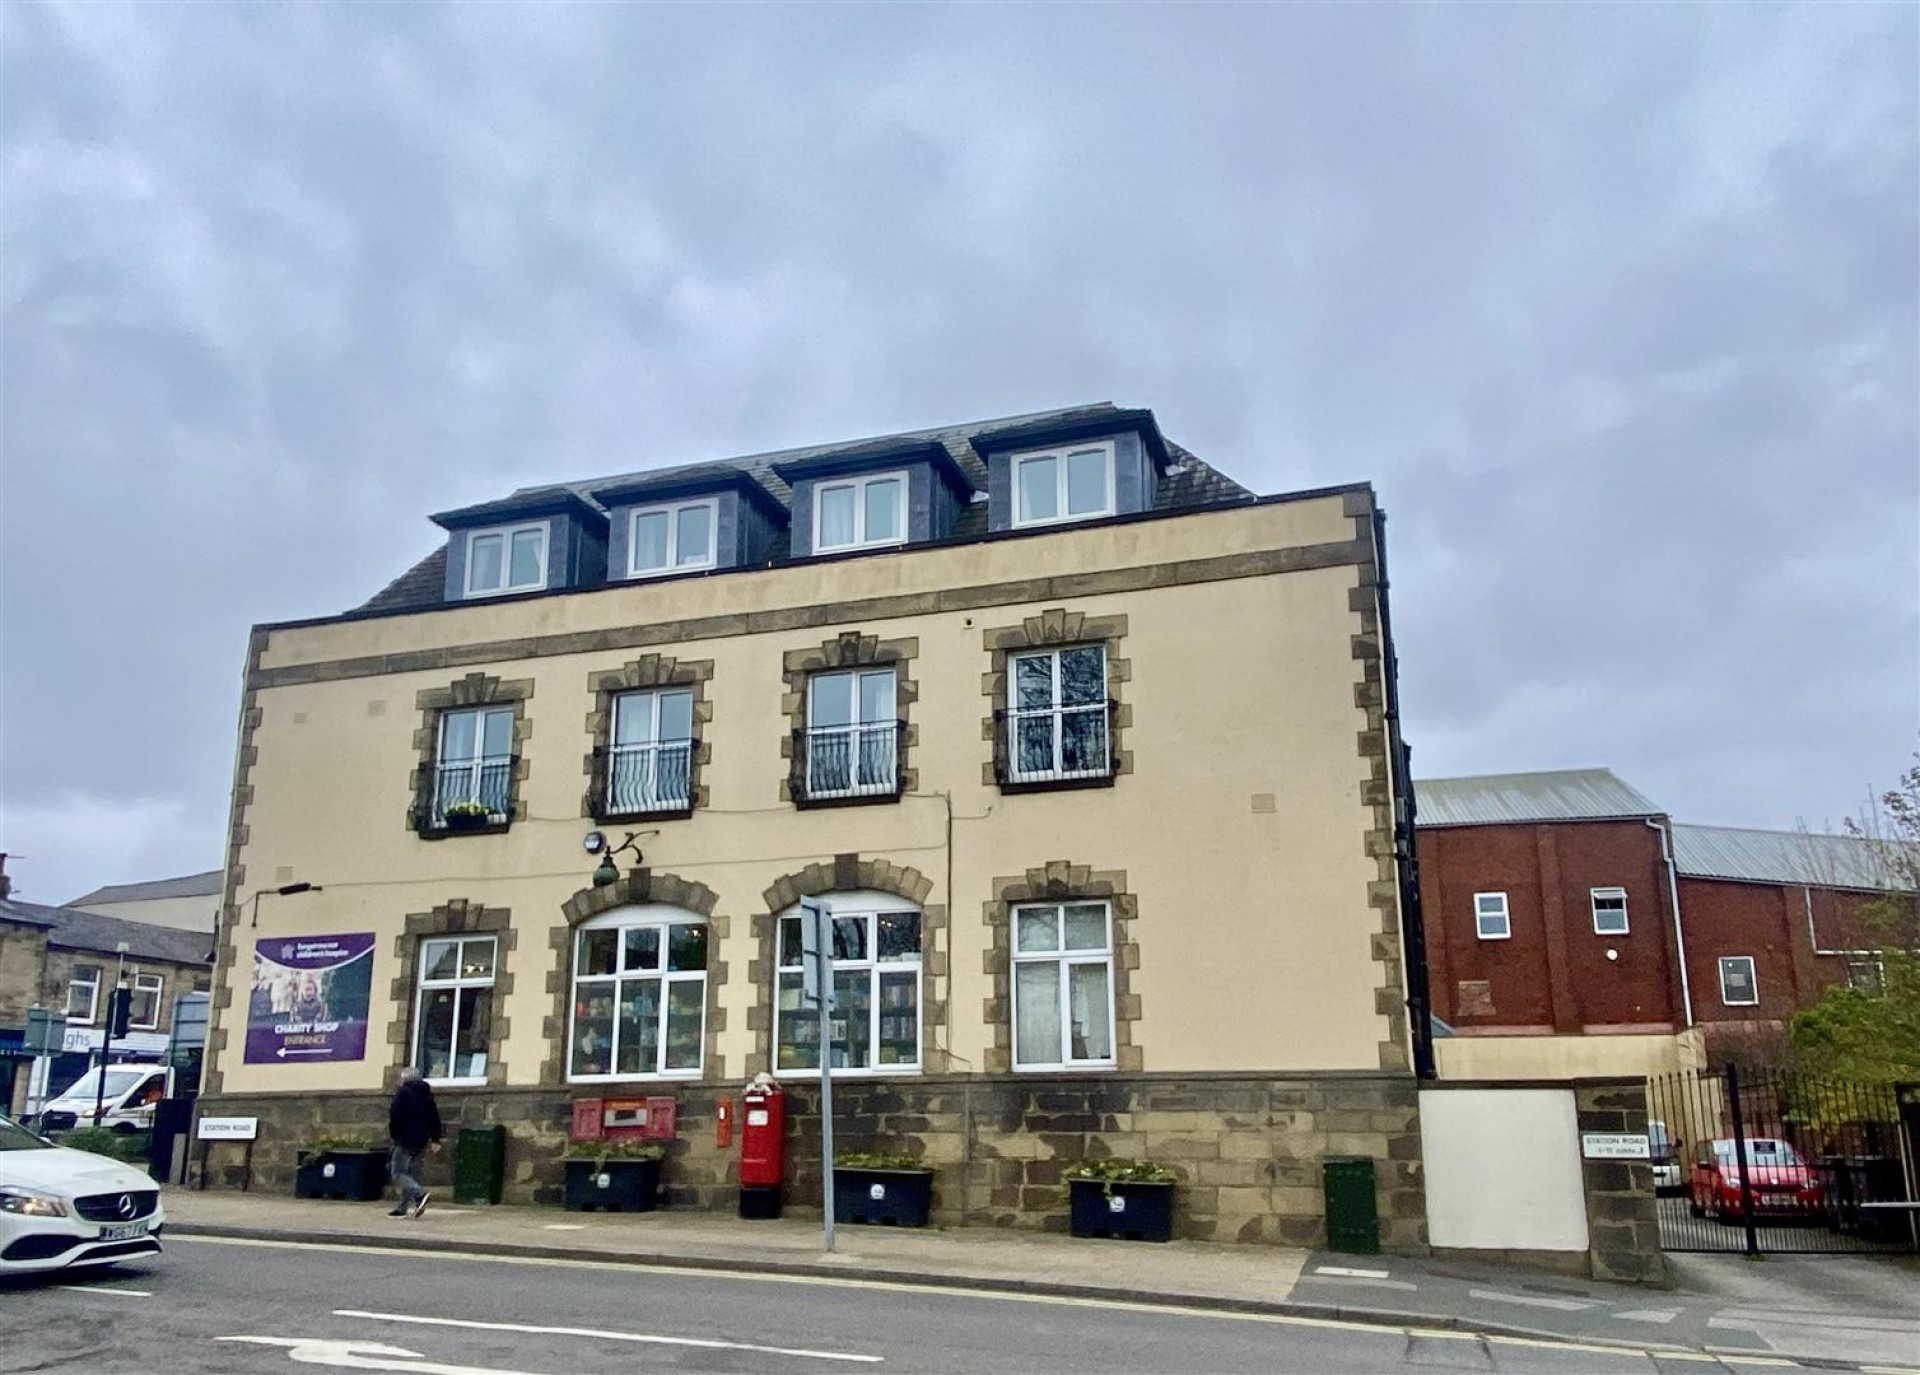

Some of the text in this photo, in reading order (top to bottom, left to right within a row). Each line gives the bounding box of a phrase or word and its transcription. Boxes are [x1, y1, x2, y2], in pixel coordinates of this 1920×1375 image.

[274, 1021, 340, 1034] CHARITY SHOP
[64, 1030, 90, 1049] ghs
[284, 1034, 326, 1046] ENTRANCE
